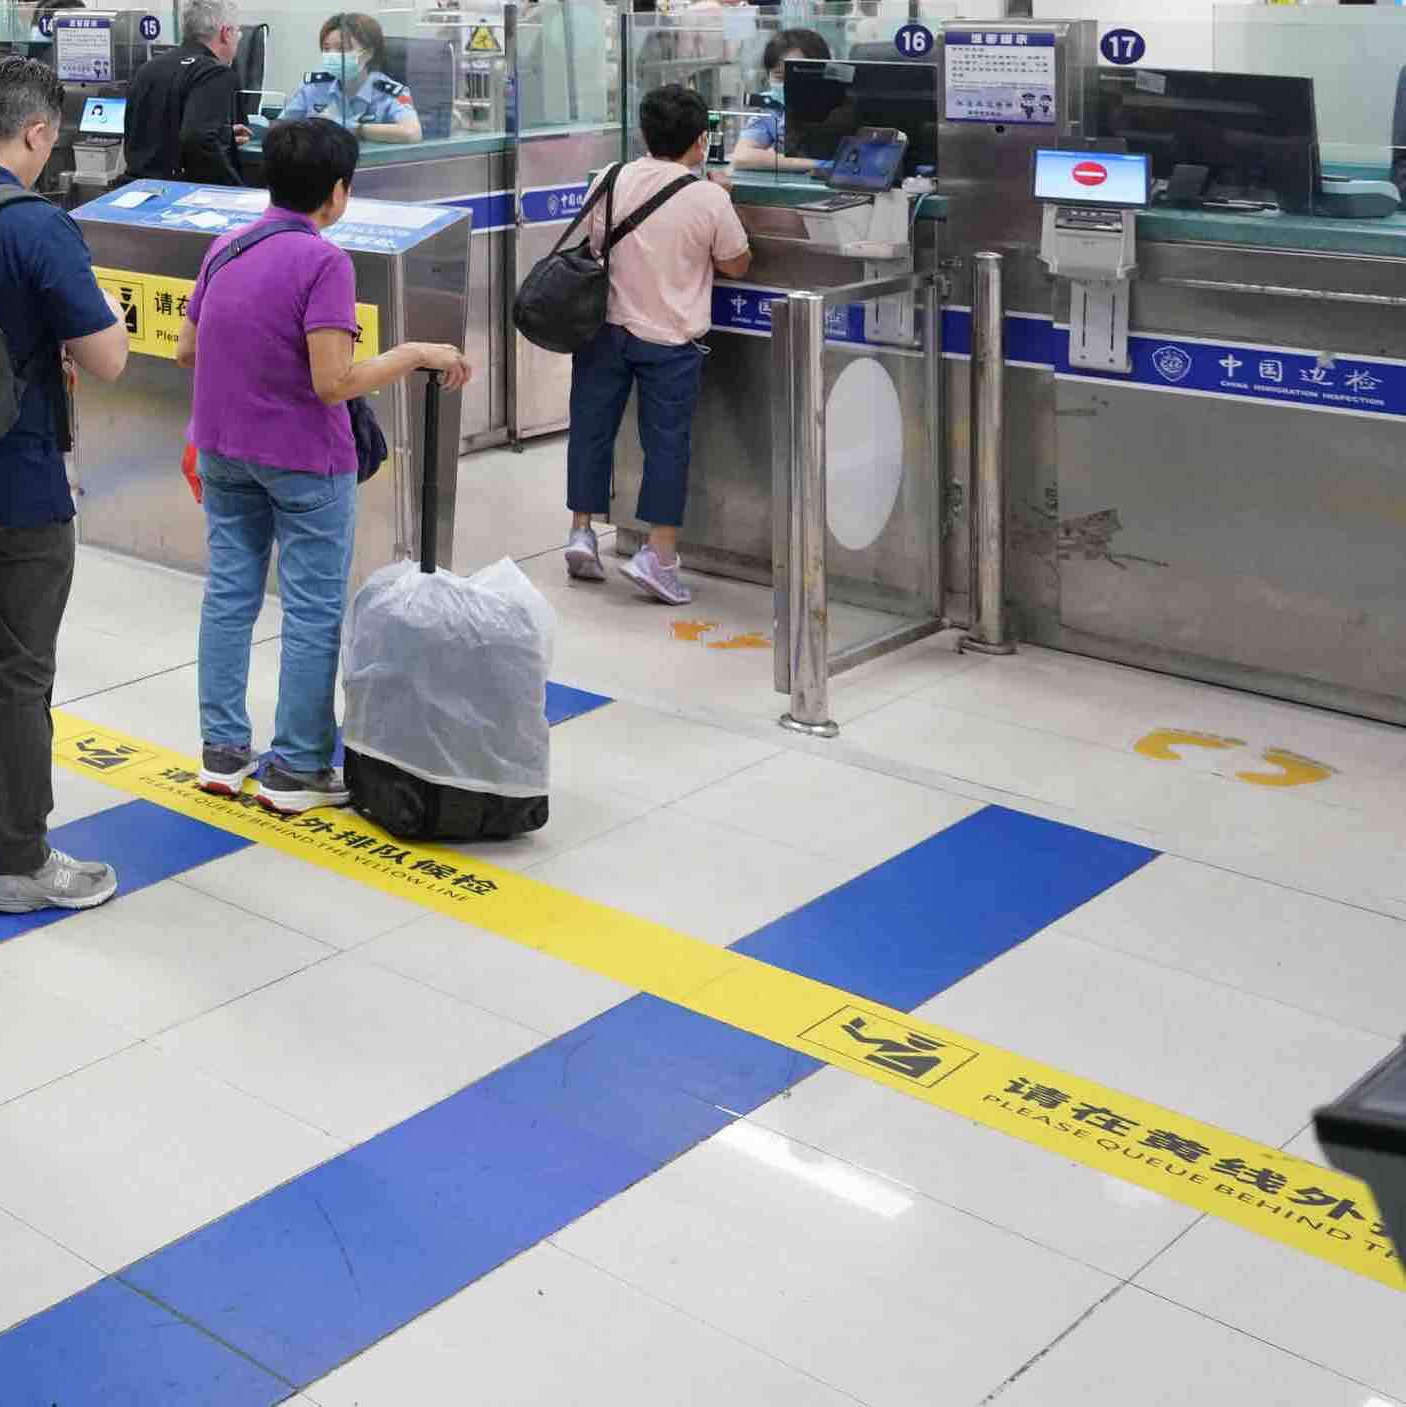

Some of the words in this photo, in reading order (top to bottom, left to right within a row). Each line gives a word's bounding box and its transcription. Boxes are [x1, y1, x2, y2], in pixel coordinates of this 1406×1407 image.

[143, 20, 157, 35] 15
[902, 32, 926, 51] 16
[1109, 36, 1136, 58] 17
[156, 330, 179, 342] Plea
[1219, 353, 1384, 393] 中国边检
[1220, 380, 1249, 390] CHINA
[1253, 383, 1319, 398] IMMIGRATION
[1322, 393, 1384, 406] INSPECTION
[317, 841, 349, 857] THE
[354, 855, 427, 885] YELLOW
[427, 883, 474, 902] LINE
[981, 1093, 1091, 1138] PLEASE
[1097, 1137, 1207, 1185] QUEUE
[1215, 1183, 1352, 1242] BEHIND
